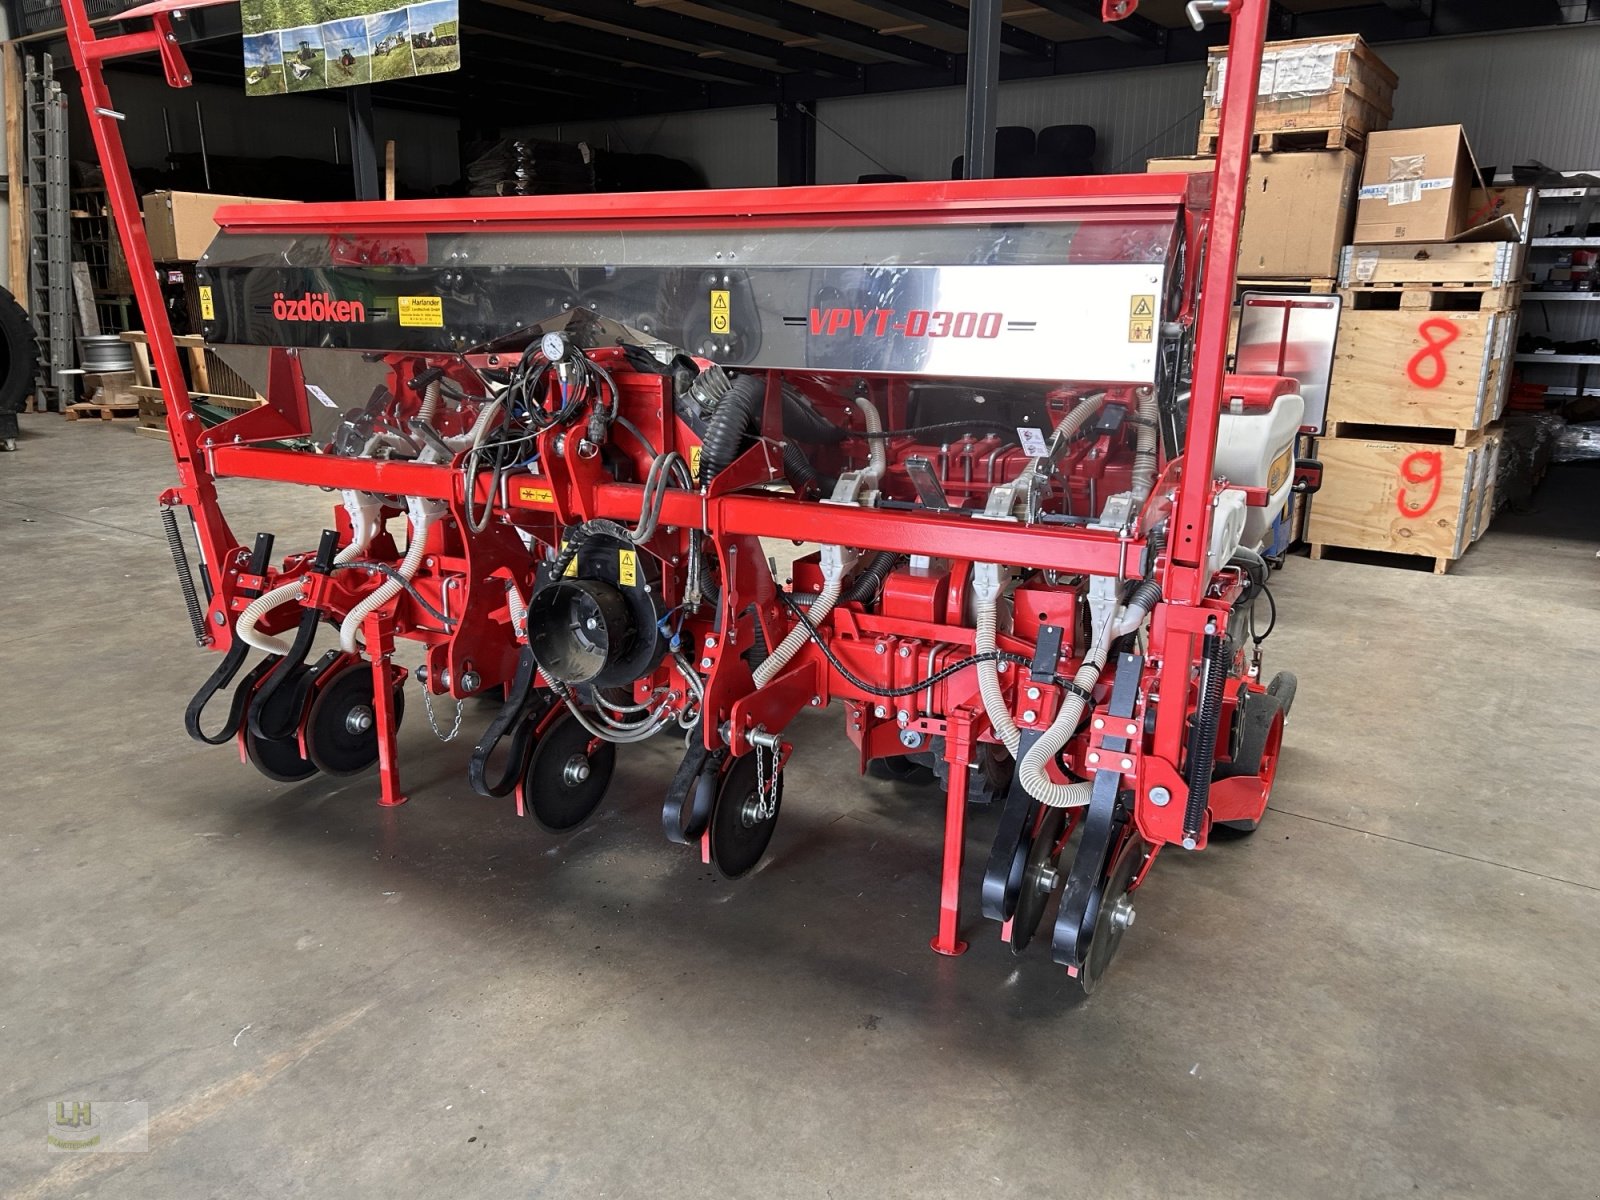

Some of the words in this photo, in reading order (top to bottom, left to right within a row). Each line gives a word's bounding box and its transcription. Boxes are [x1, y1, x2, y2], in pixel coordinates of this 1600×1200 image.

[273, 292, 365, 322] özdöken
[1407, 317, 1460, 389] 8
[1397, 451, 1442, 519] 9
